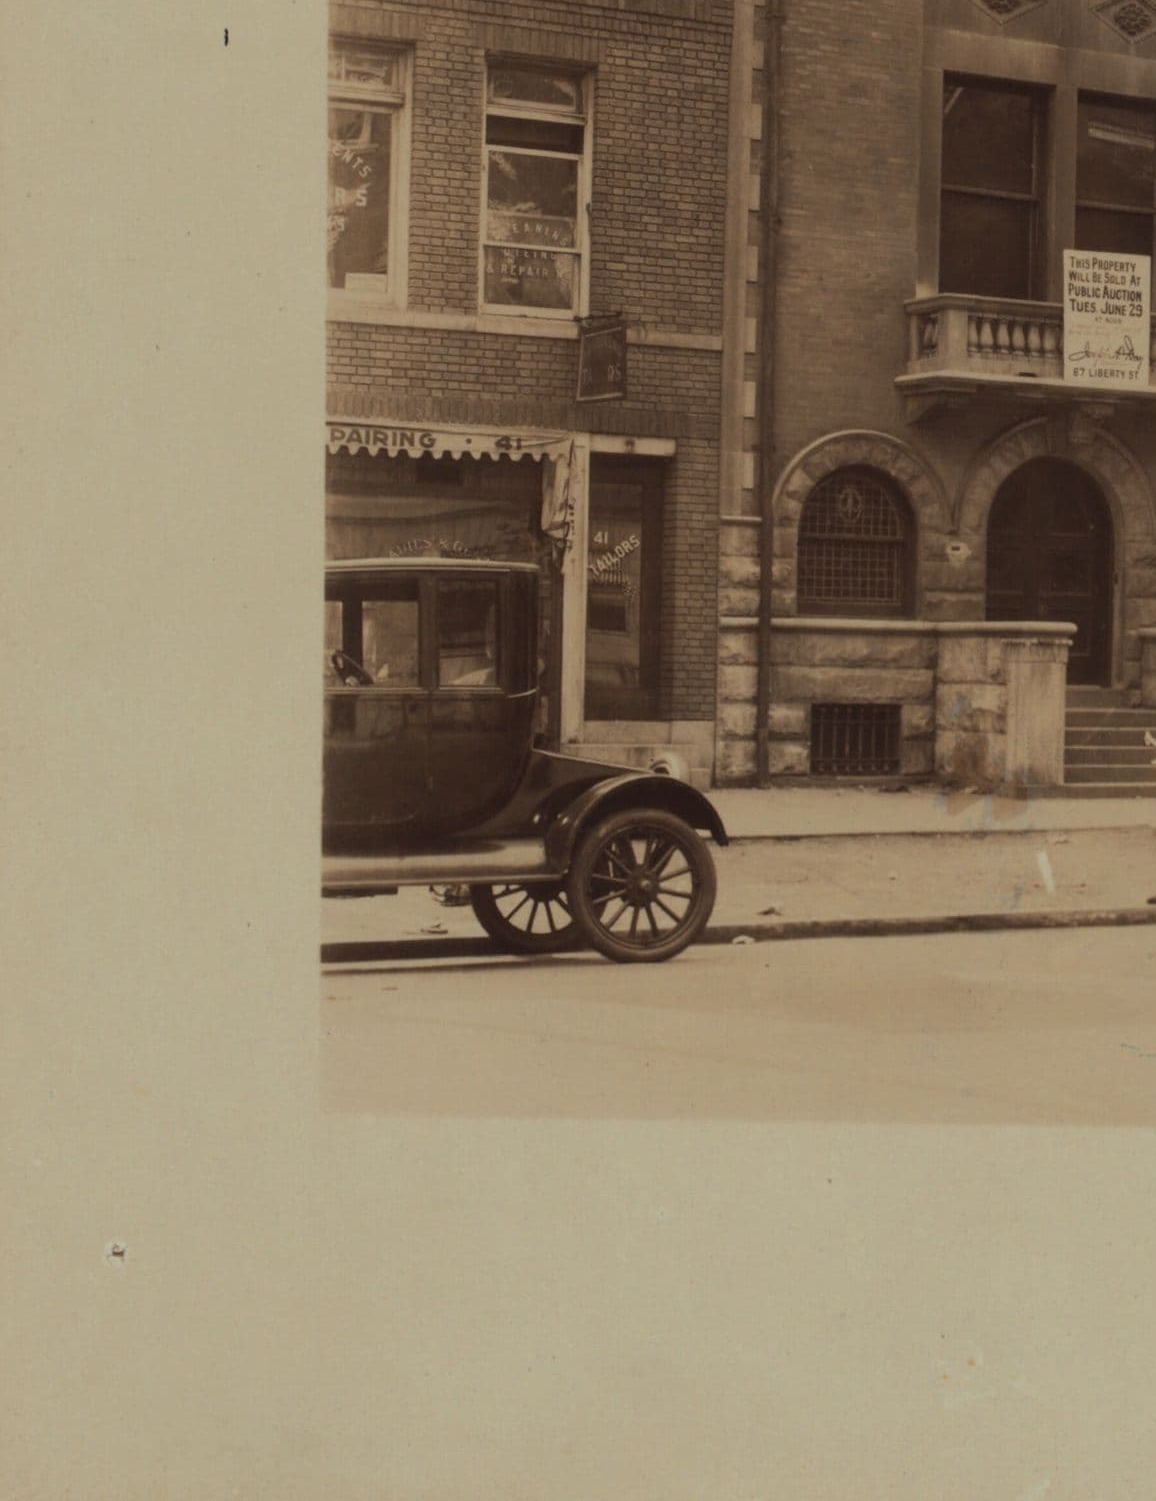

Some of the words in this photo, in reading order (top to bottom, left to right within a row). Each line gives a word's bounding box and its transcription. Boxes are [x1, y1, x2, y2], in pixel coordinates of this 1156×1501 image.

[1070, 256, 1091, 269] THIS
[1092, 257, 1137, 273] PROPERTY
[1068, 271, 1090, 283] WILL
[1093, 272, 1103, 284] BE
[1104, 272, 1127, 286] SOLD
[1130, 274, 1142, 287] AT
[1068, 283, 1101, 298] PUBLIC
[1102, 286, 1142, 302] AUCTION
[1100, 301, 1128, 316] JUNE
[1129, 303, 1143, 317] 29
[1088, 367, 1126, 379] LIBERTY
[330, 427, 437, 449] PAIRING
[494, 435, 522, 450] 41
[592, 531, 609, 544] 41
[588, 535, 641, 575] TAILORS
